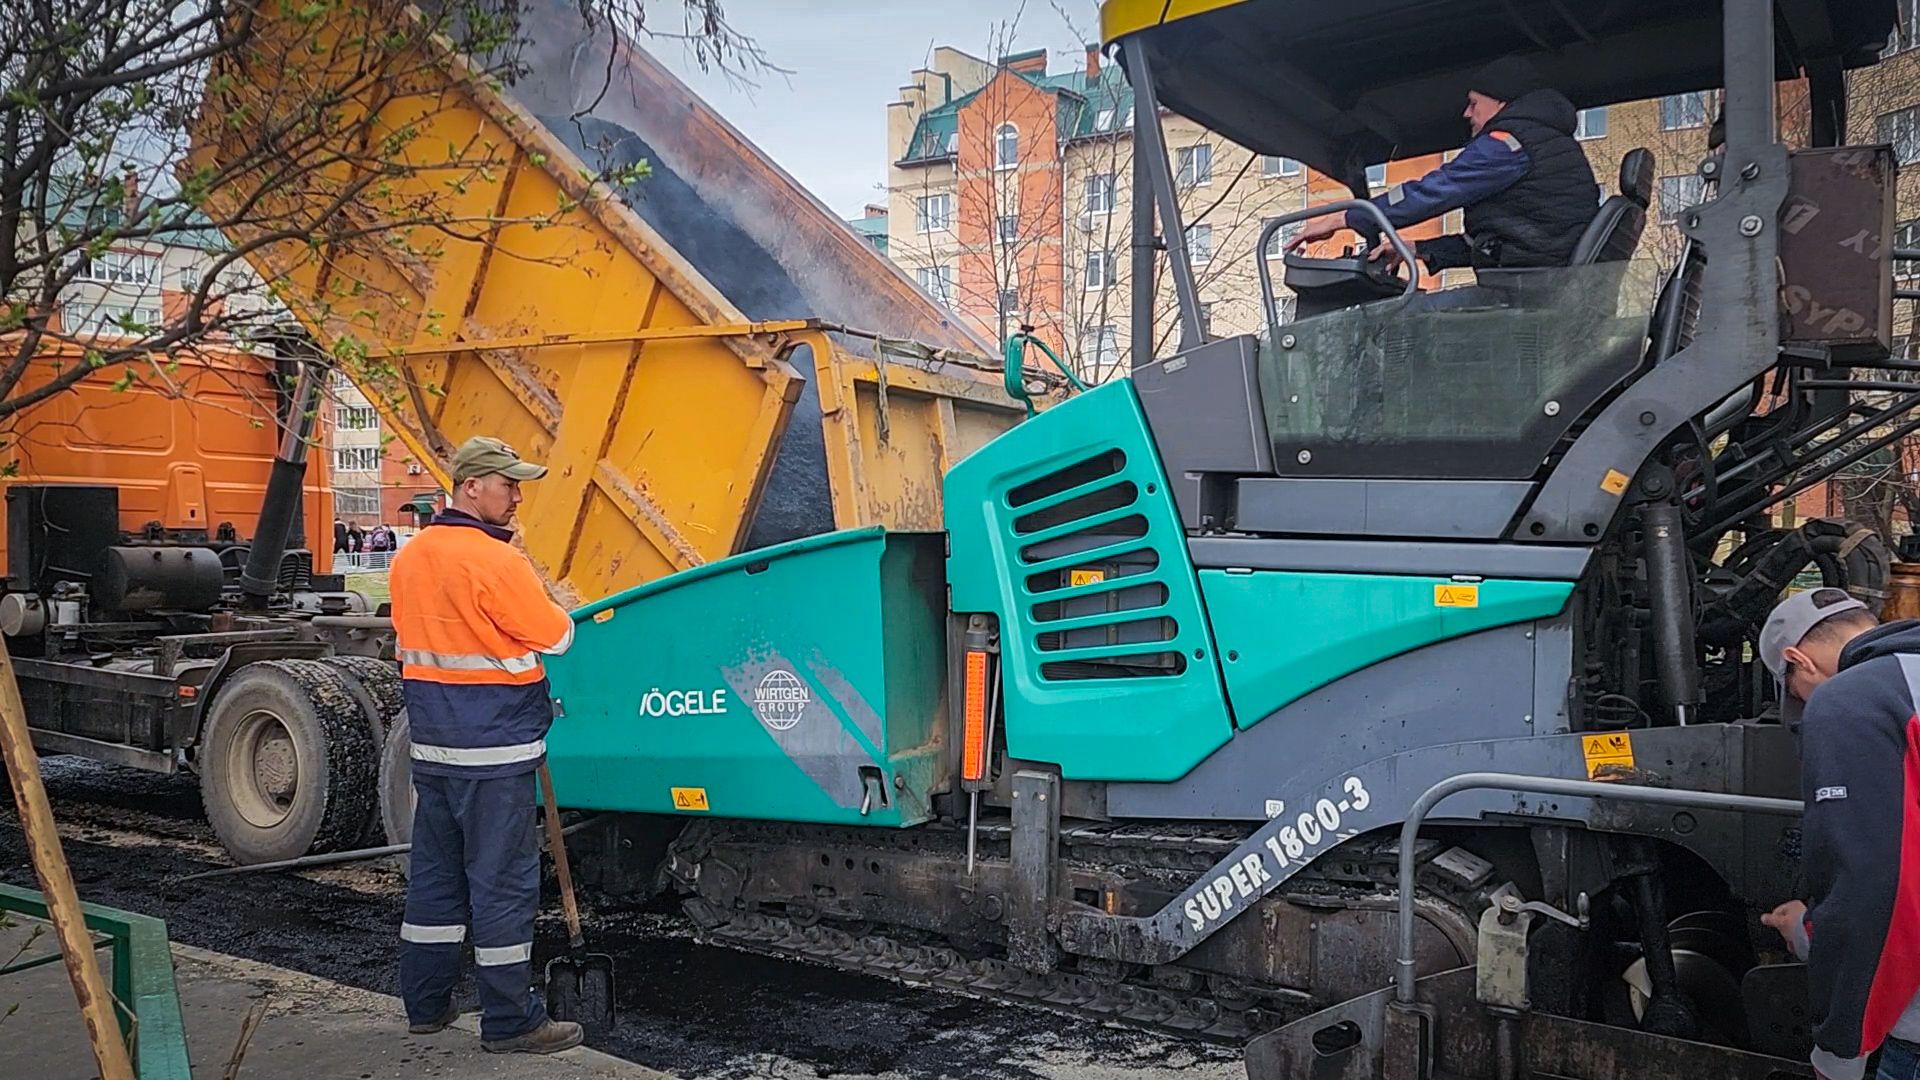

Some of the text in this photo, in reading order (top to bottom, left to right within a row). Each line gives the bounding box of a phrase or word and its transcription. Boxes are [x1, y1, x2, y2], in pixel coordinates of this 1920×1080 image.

[754, 687, 809, 700] WIRTGEN
[758, 702, 805, 713] GROUP
[1184, 776, 1371, 932] SUPER 1800-3
